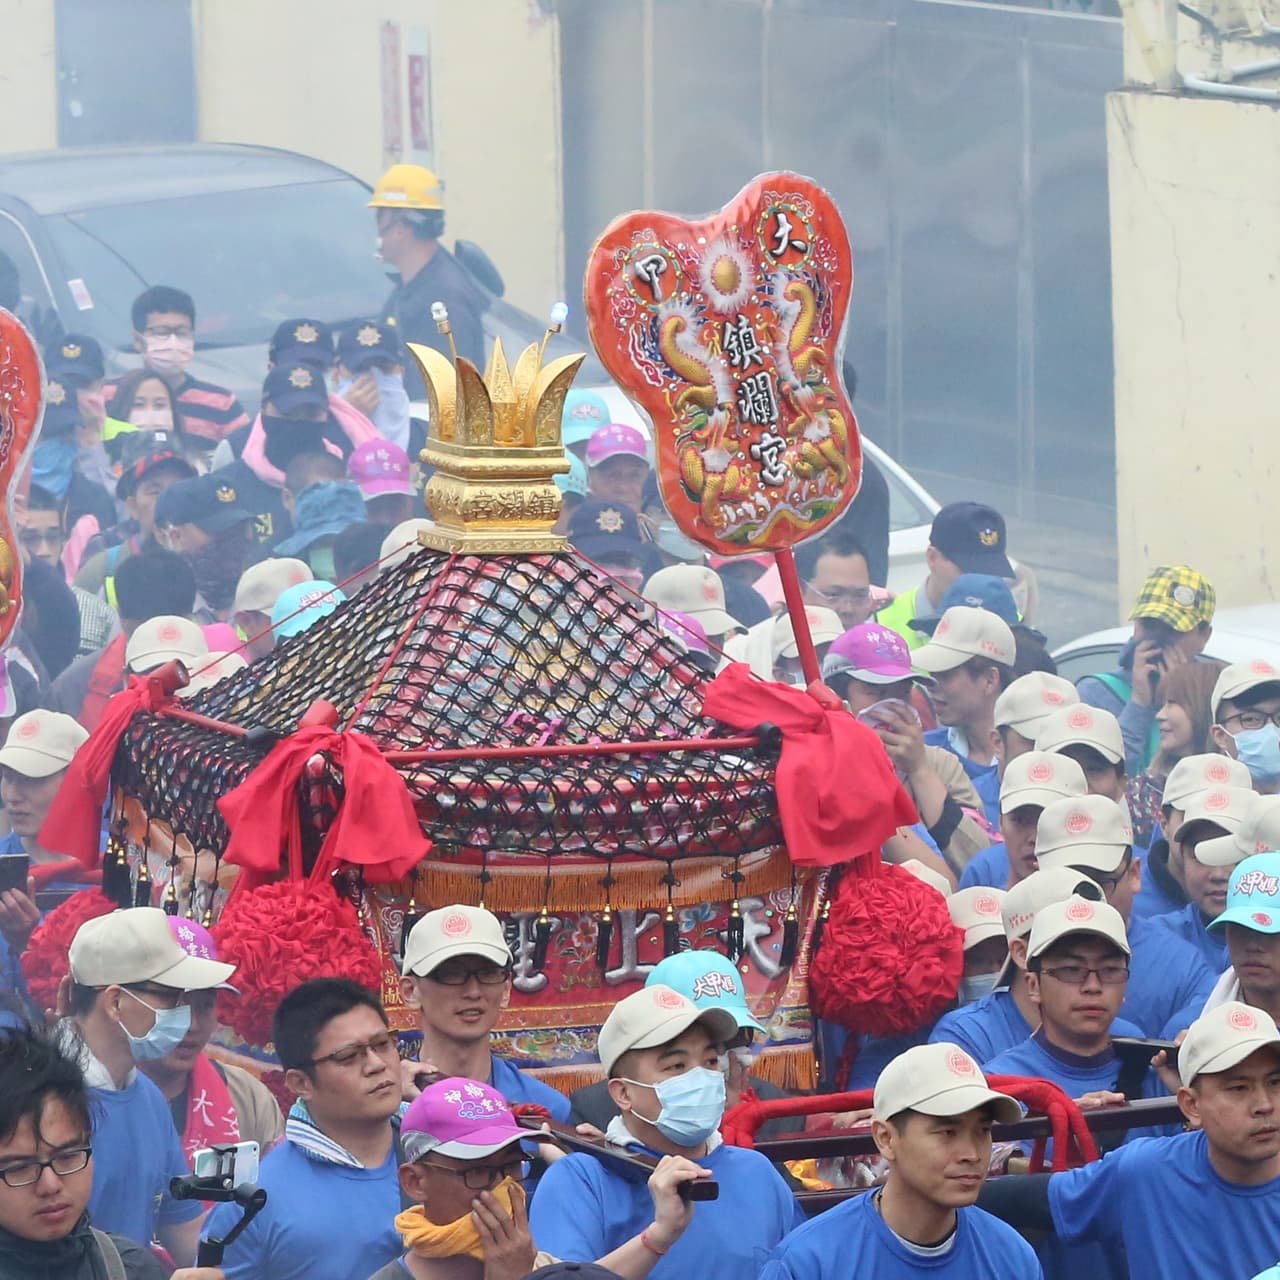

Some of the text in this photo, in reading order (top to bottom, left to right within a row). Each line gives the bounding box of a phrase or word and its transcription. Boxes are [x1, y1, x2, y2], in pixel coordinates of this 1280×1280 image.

[634, 211, 809, 302] 大 甲
[722, 313, 788, 487] 鎮瀾宮
[1233, 869, 1280, 898] 大甲媽
[693, 970, 738, 1000] 大甲媽
